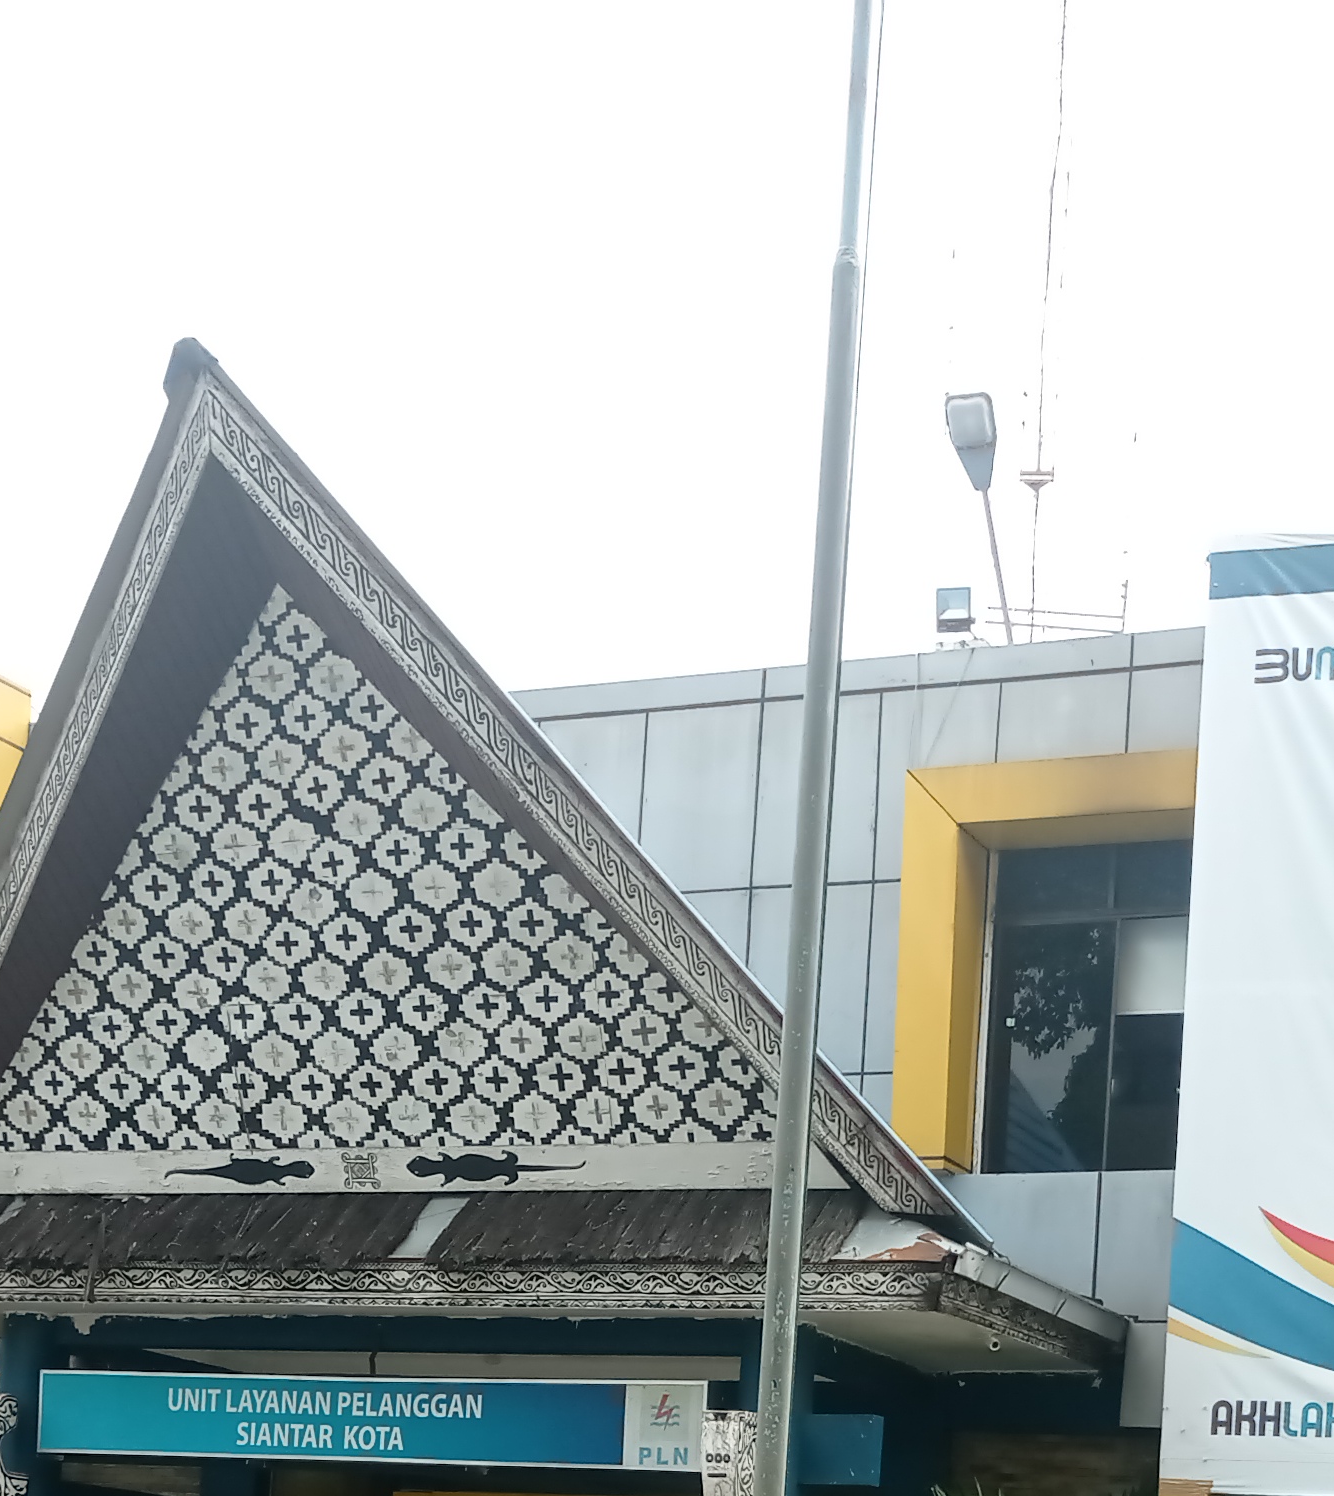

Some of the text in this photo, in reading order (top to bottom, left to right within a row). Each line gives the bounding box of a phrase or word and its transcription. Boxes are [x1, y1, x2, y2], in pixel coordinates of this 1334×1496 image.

[167, 1387, 483, 1419] UNIT LAYANAN PELANGGAN
[235, 1422, 404, 1451] SIANTAR KOTA
[638, 1446, 689, 1466] PLN
